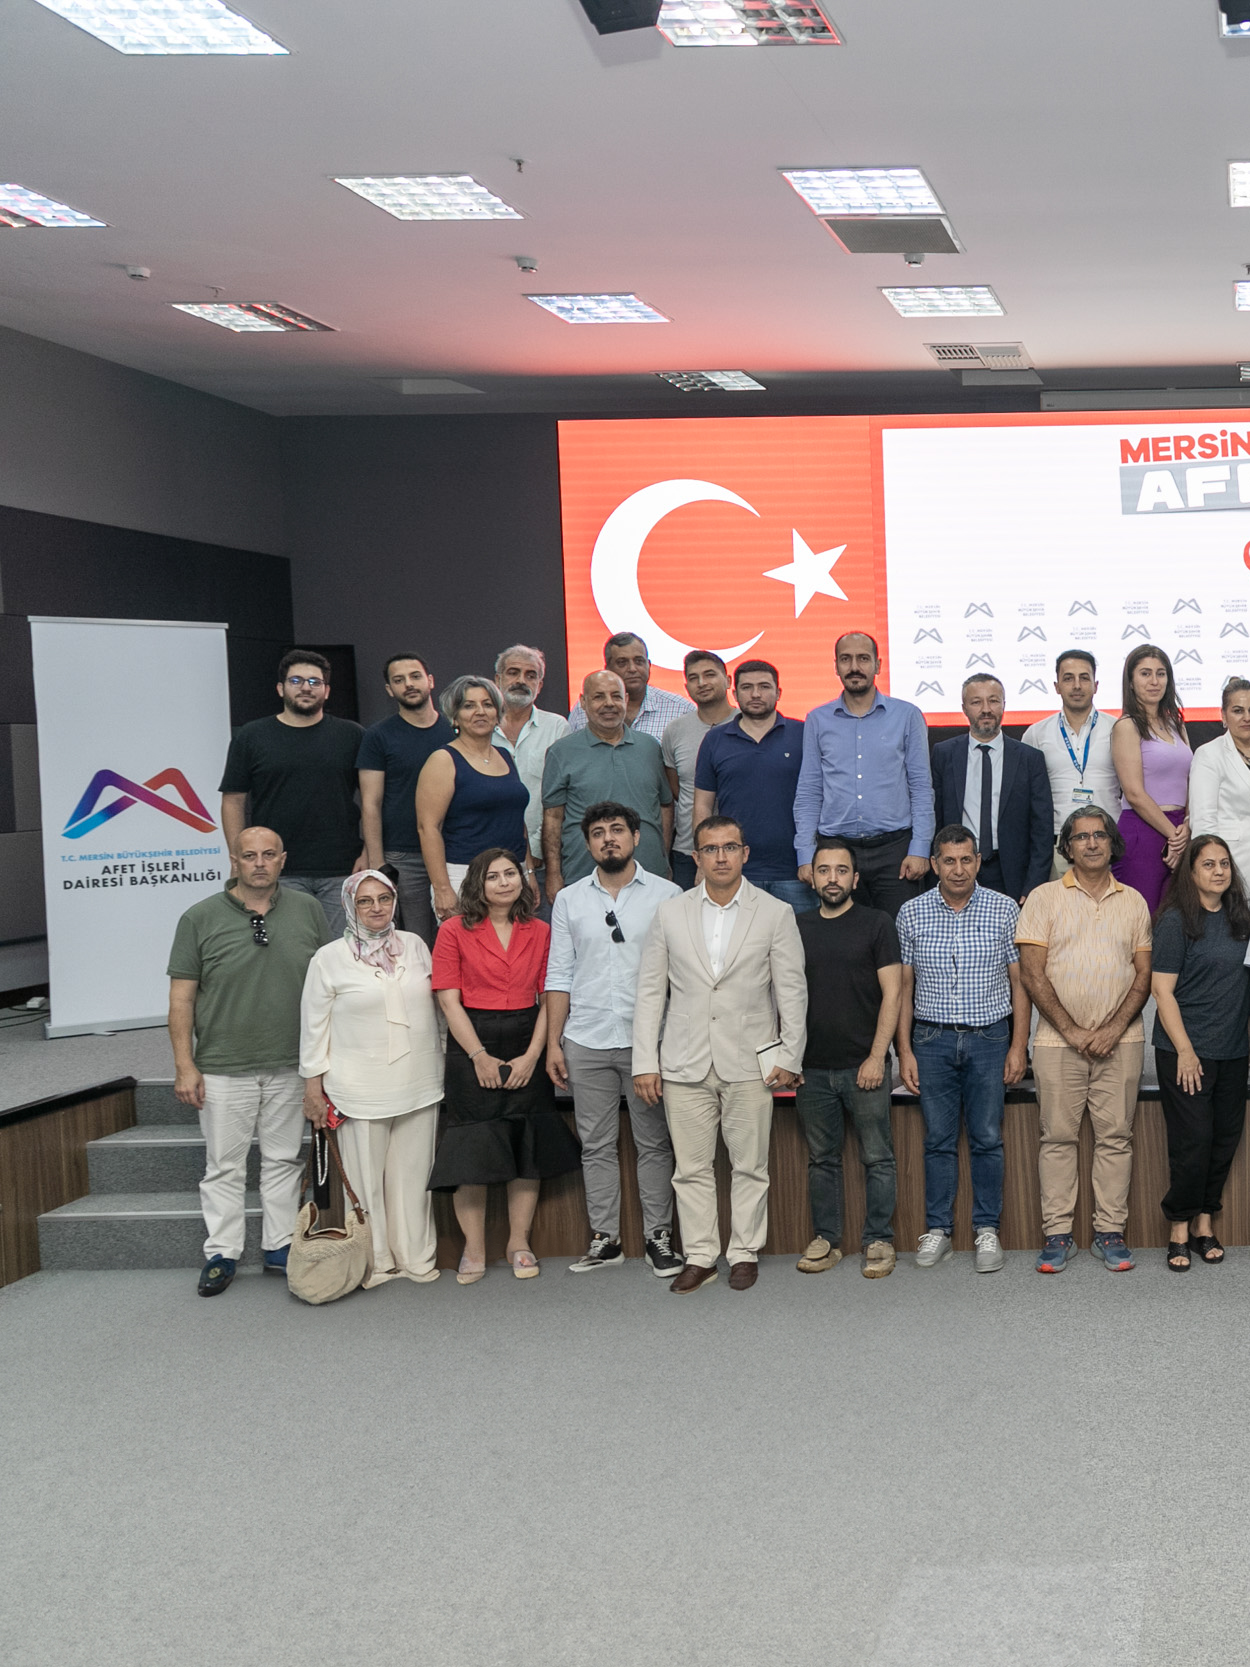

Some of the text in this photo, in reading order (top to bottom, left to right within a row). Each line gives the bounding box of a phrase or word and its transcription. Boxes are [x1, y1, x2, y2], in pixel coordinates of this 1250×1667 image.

[79, 852, 114, 861] MERSİN
[117, 849, 173, 859] BÜYÜKŞEHİR
[175, 846, 221, 856] BELEDİYESİ
[101, 858, 185, 875] AFET İŞLERİ
[63, 869, 221, 890] DAİRESİ BAŞKANLIĞI
